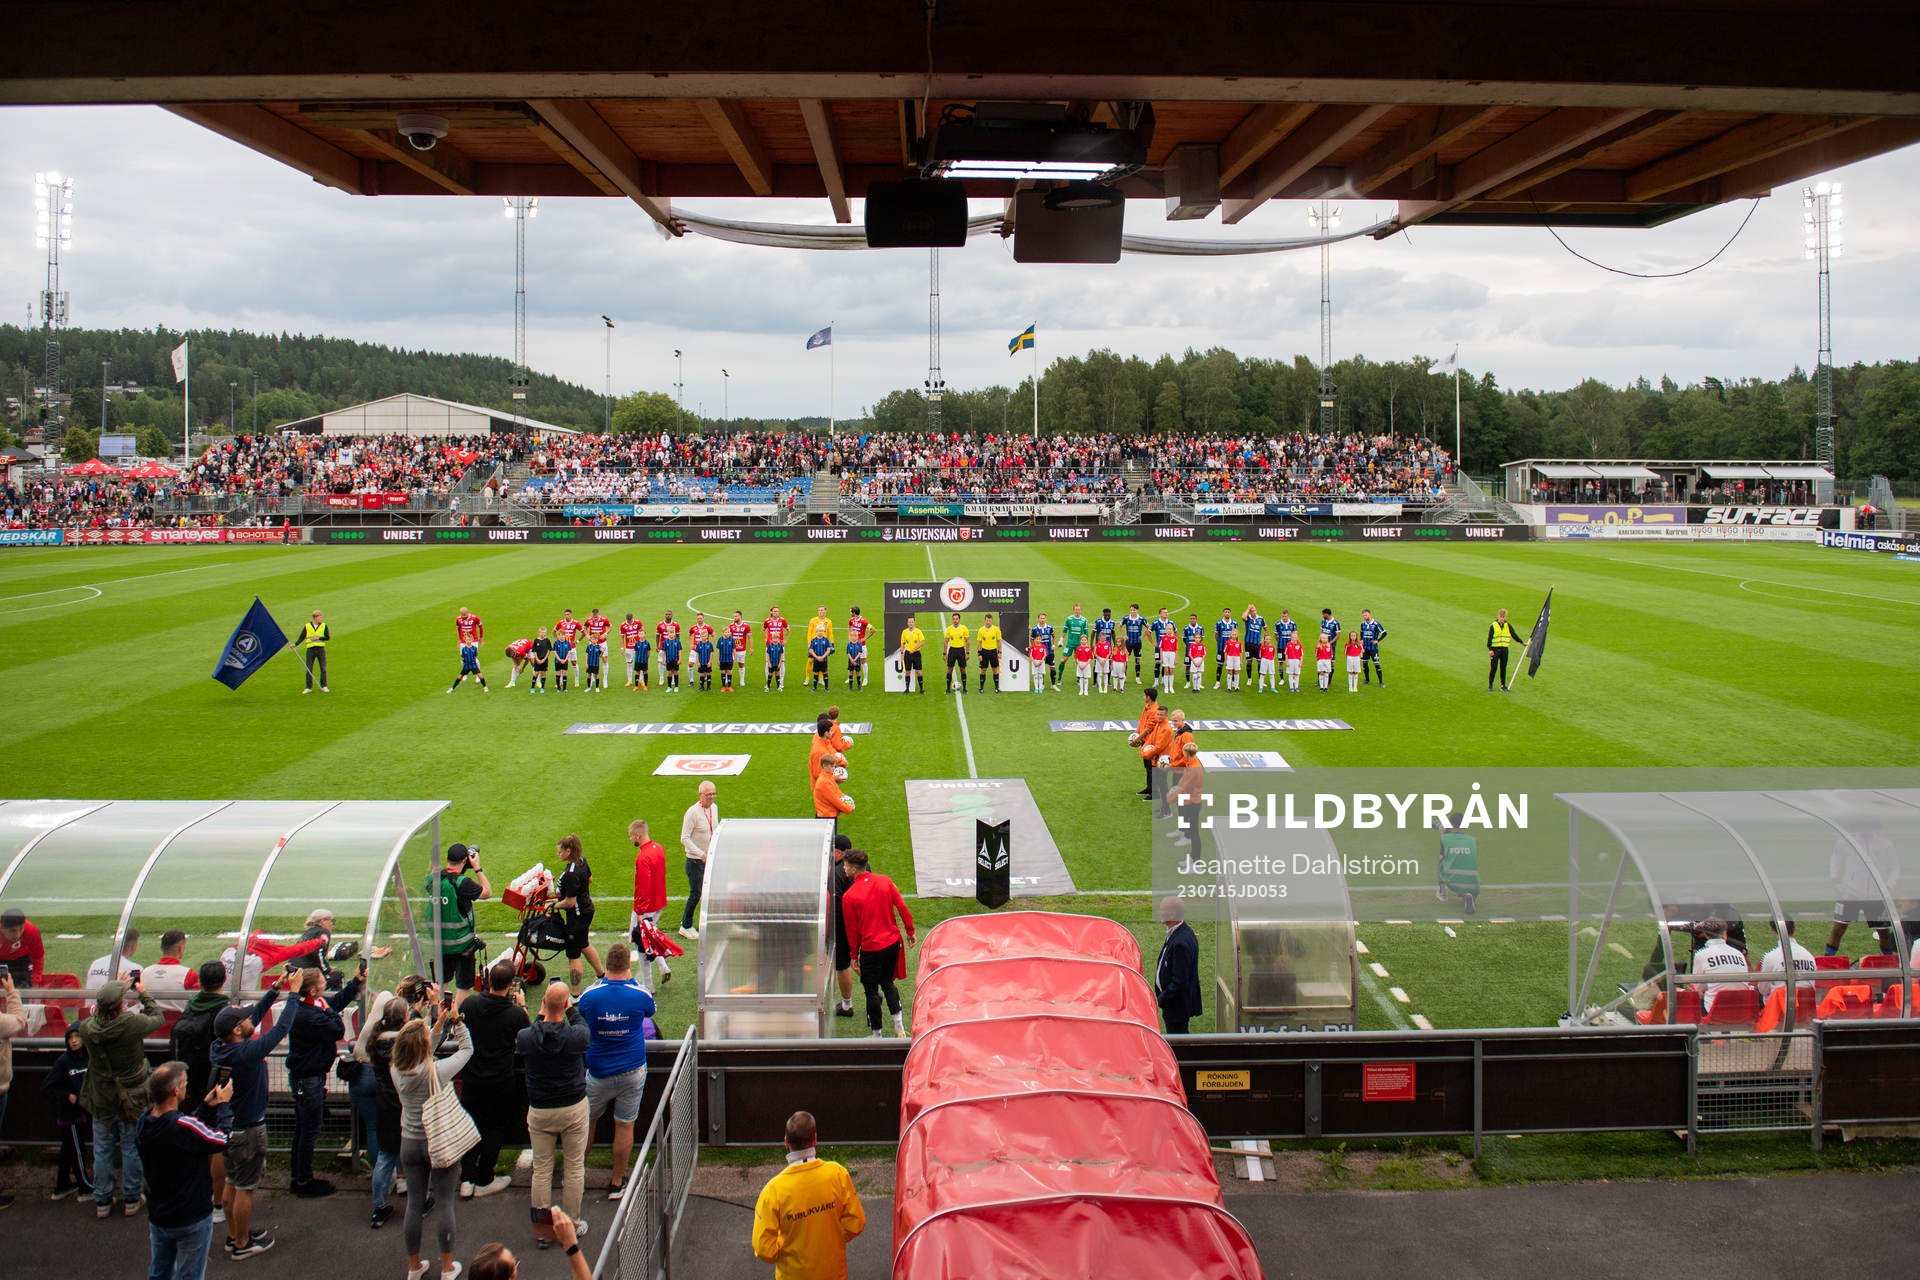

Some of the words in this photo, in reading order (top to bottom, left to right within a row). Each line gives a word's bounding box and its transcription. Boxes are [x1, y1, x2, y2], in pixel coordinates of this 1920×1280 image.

[908, 506, 950, 514] Assemblin
[1222, 505, 1264, 514] Munkfors
[151, 530, 220, 542] smarteyes
[383, 530, 424, 540] UNIBET
[488, 530, 529, 540] UNIBET
[594, 530, 636, 540] UNIBET
[701, 530, 742, 539] UNIBET
[808, 529, 848, 538] UNIBET
[895, 527, 958, 541] ALLSVENSKAN
[1050, 528, 1090, 538] UNIBET
[1155, 528, 1195, 538] UNIBET
[1258, 528, 1299, 538] UNIBET
[1363, 528, 1402, 538] UNIBET
[1465, 528, 1504, 538] UNIBET
[1824, 532, 1875, 550] Helmia
[892, 588, 932, 598] UNIBET
[982, 588, 1022, 598] UNIBET
[1009, 660, 1020, 672] U
[615, 722, 860, 734] ALLSVENSKN
[1103, 720, 1344, 730] ALVENSKAN
[945, 876, 1041, 886] UNET
[1707, 955, 1746, 968] SIRIUS
[1781, 960, 1815, 971] RIUS
[1207, 1072, 1239, 1080] RÖKNING
[1202, 1080, 1244, 1088] FÖRBJUDEN
